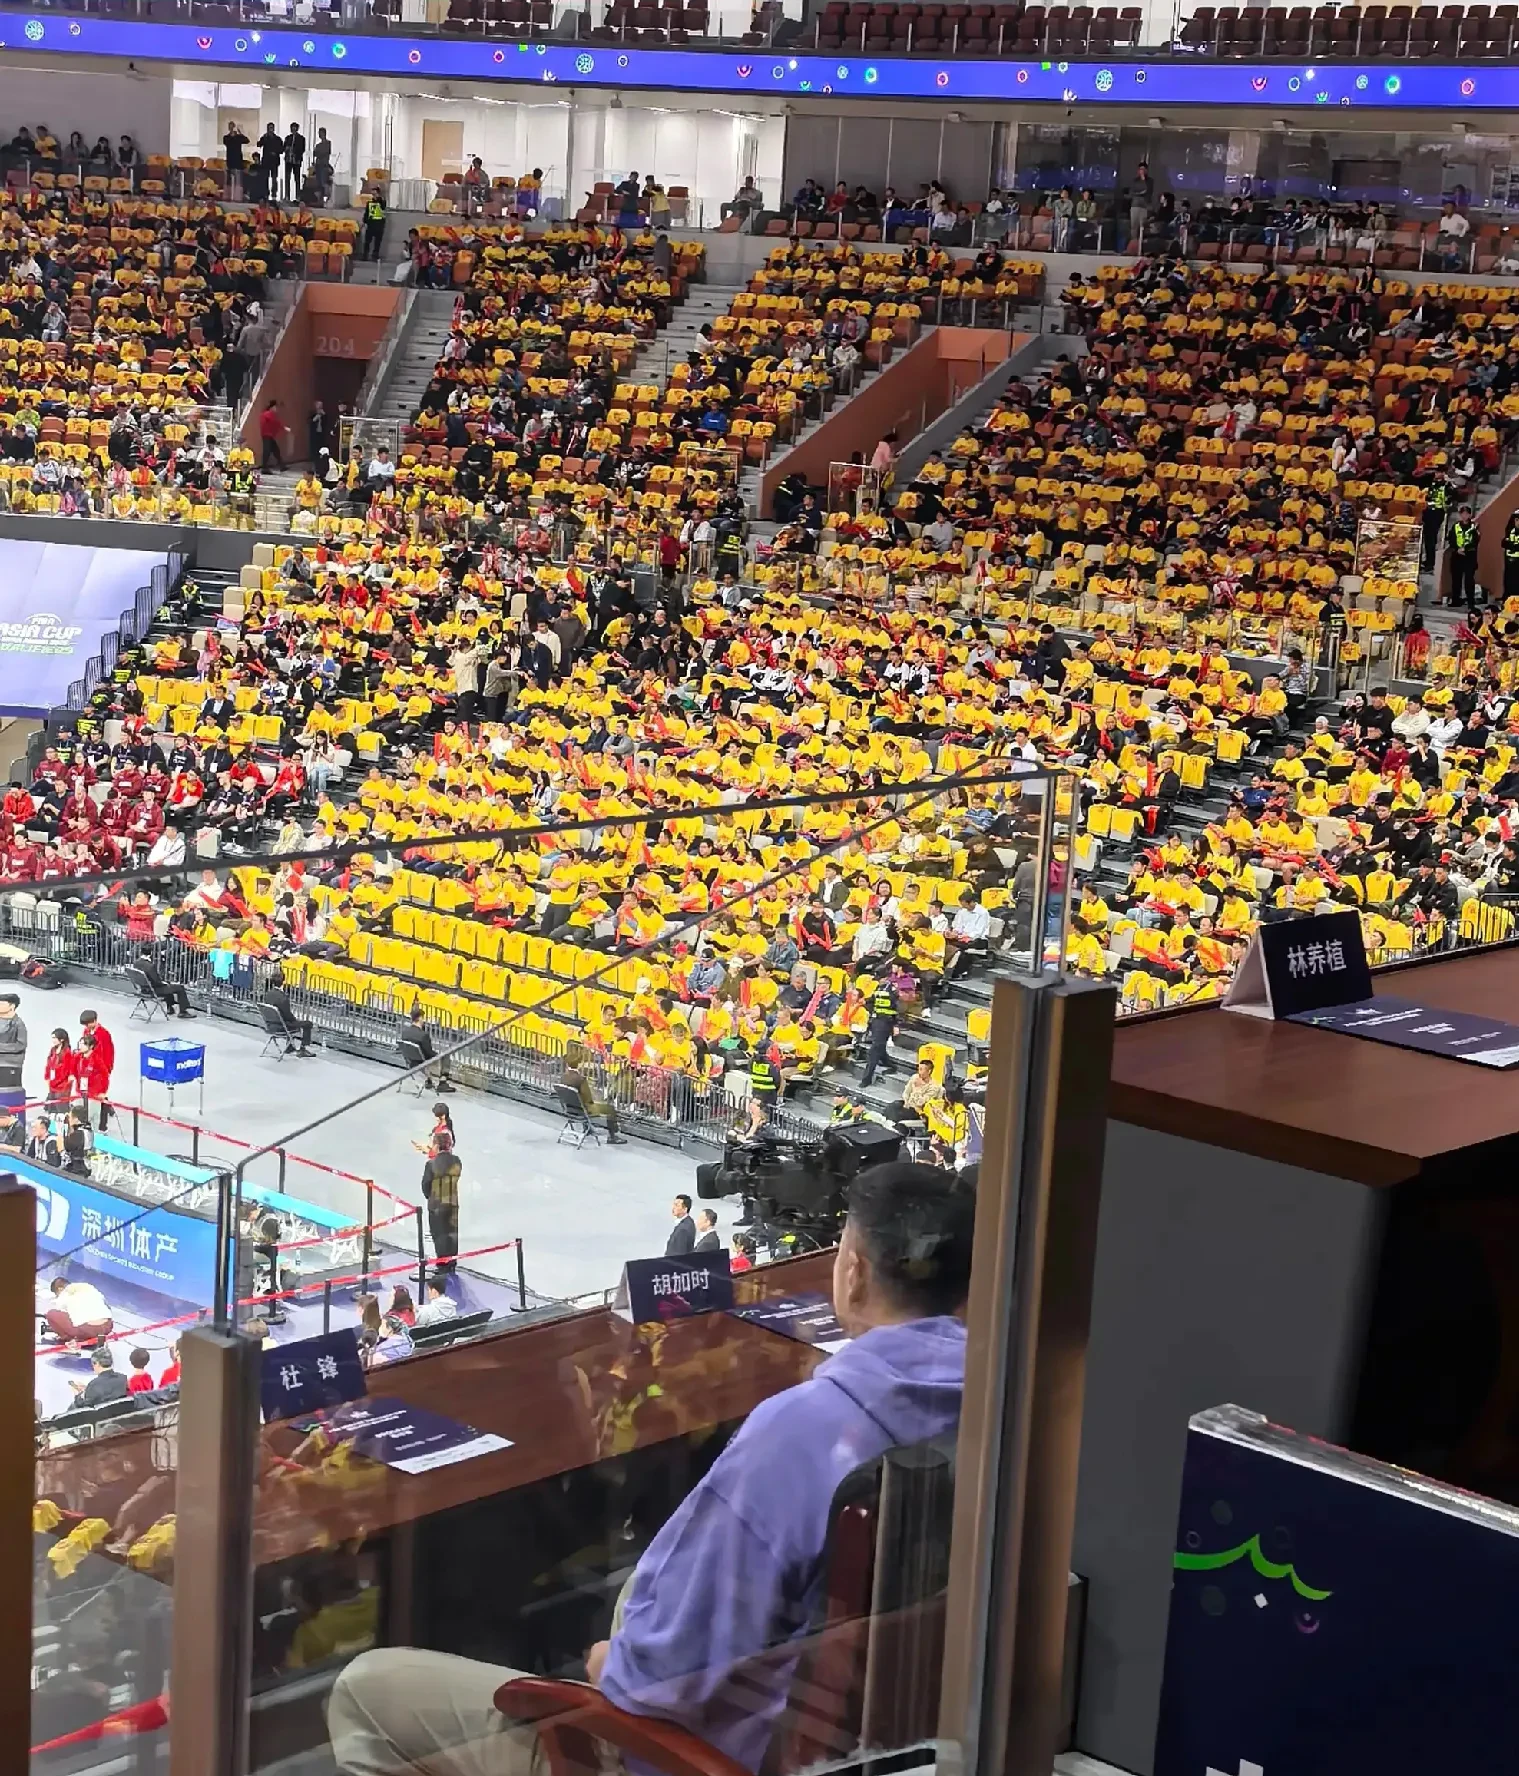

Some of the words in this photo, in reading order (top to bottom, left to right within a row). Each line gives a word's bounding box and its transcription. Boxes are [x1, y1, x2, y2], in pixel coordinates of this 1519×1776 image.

[317, 336, 354, 355] 204
[43, 626, 83, 640] CUP
[1287, 939, 1347, 979] 林养植
[81, 1206, 179, 1263] 深圳体产
[651, 1268, 711, 1296] 胡加时
